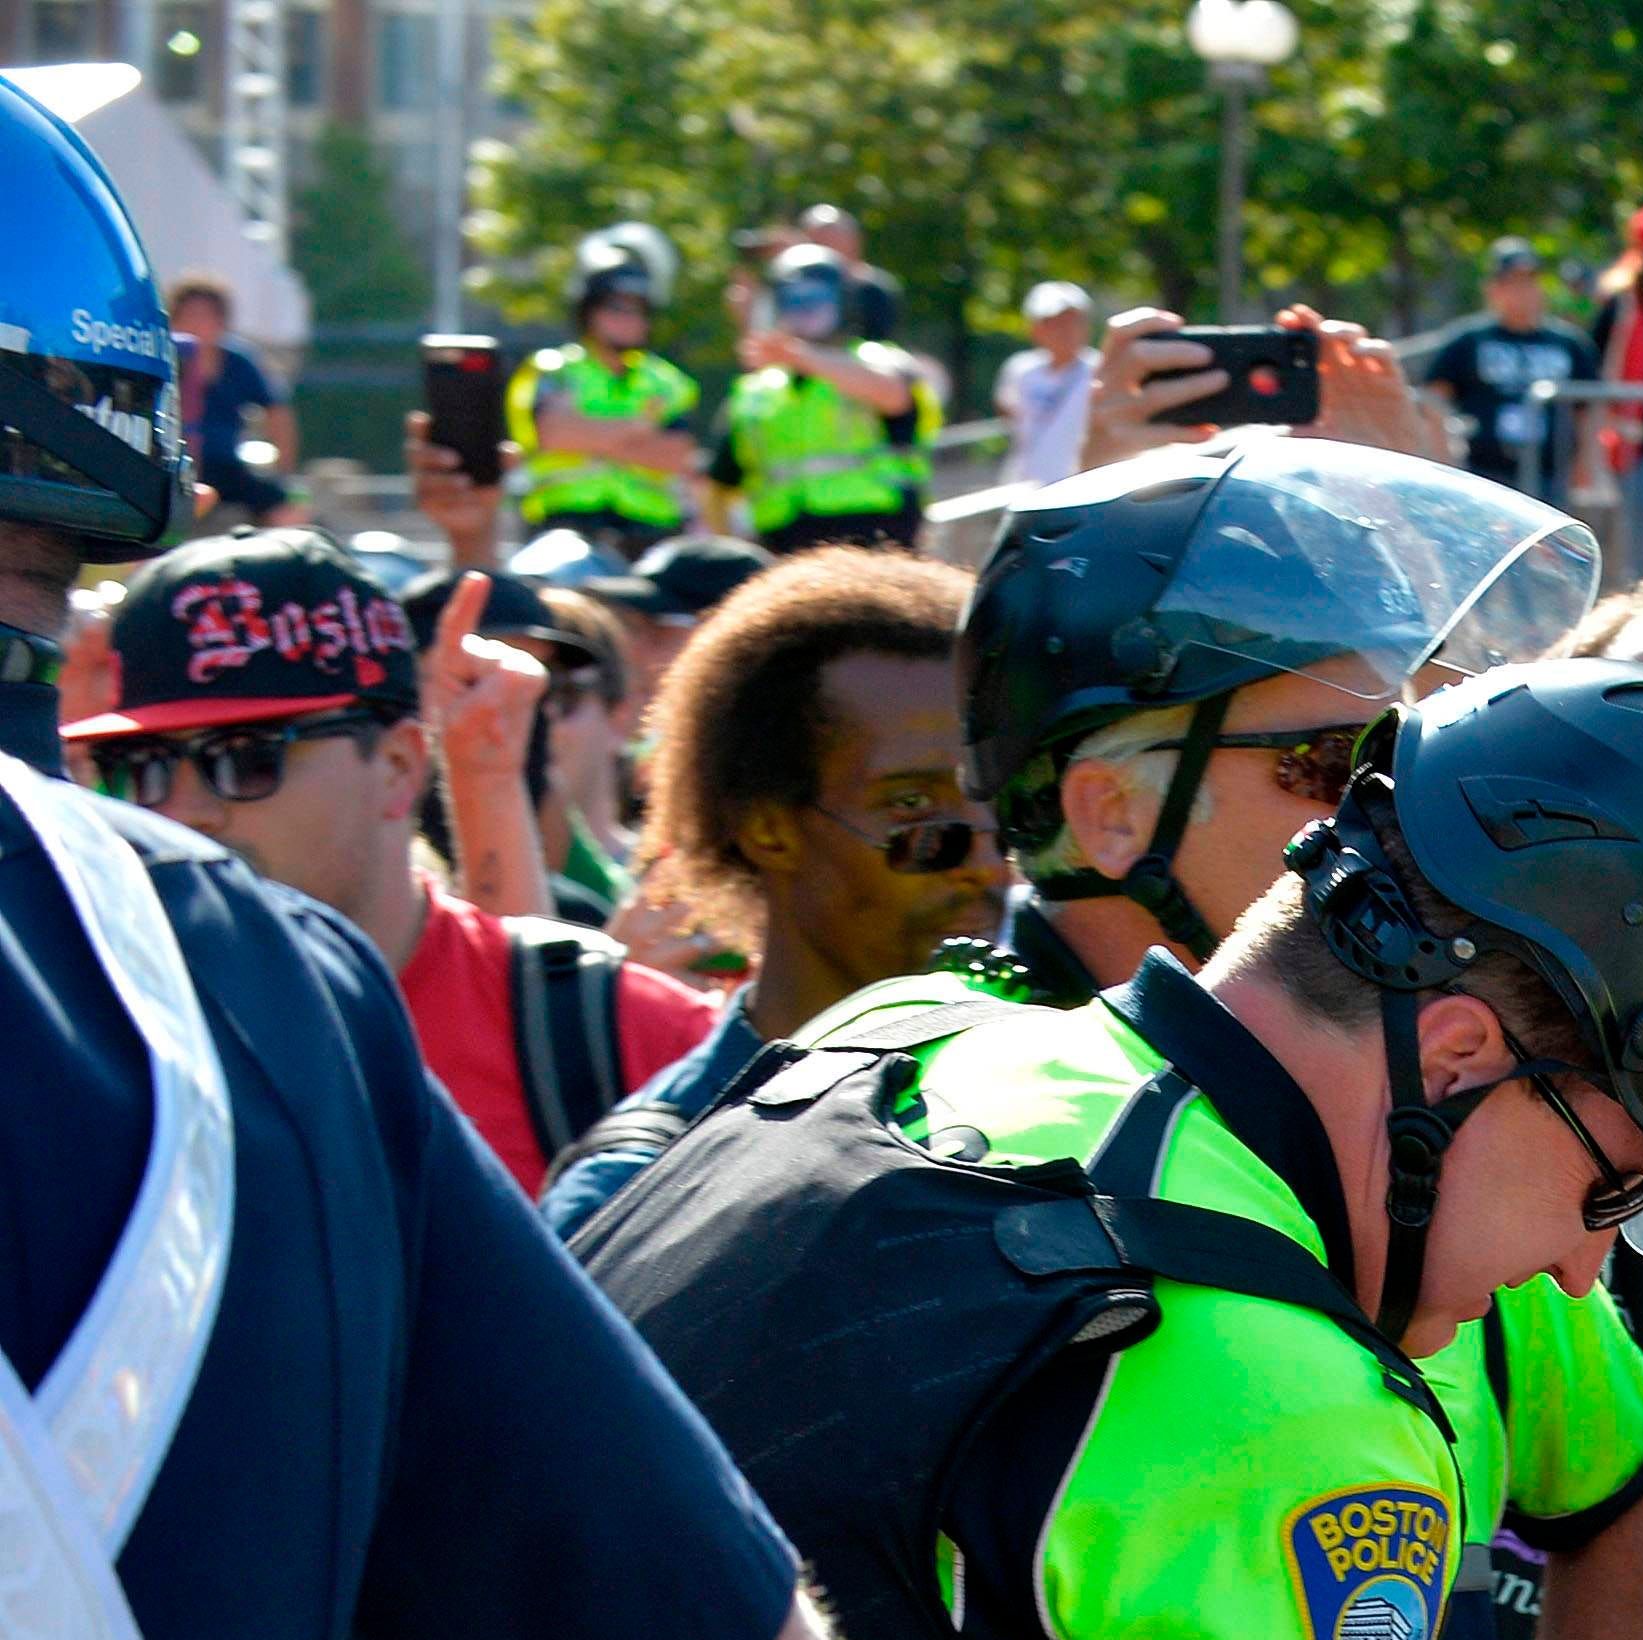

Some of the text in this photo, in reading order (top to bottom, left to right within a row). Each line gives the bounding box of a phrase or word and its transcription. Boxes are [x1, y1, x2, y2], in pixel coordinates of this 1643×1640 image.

[171, 576, 416, 684] Bosto
[1308, 1498, 1448, 1553] BOSTON
[1326, 1537, 1440, 1587] POLICE
